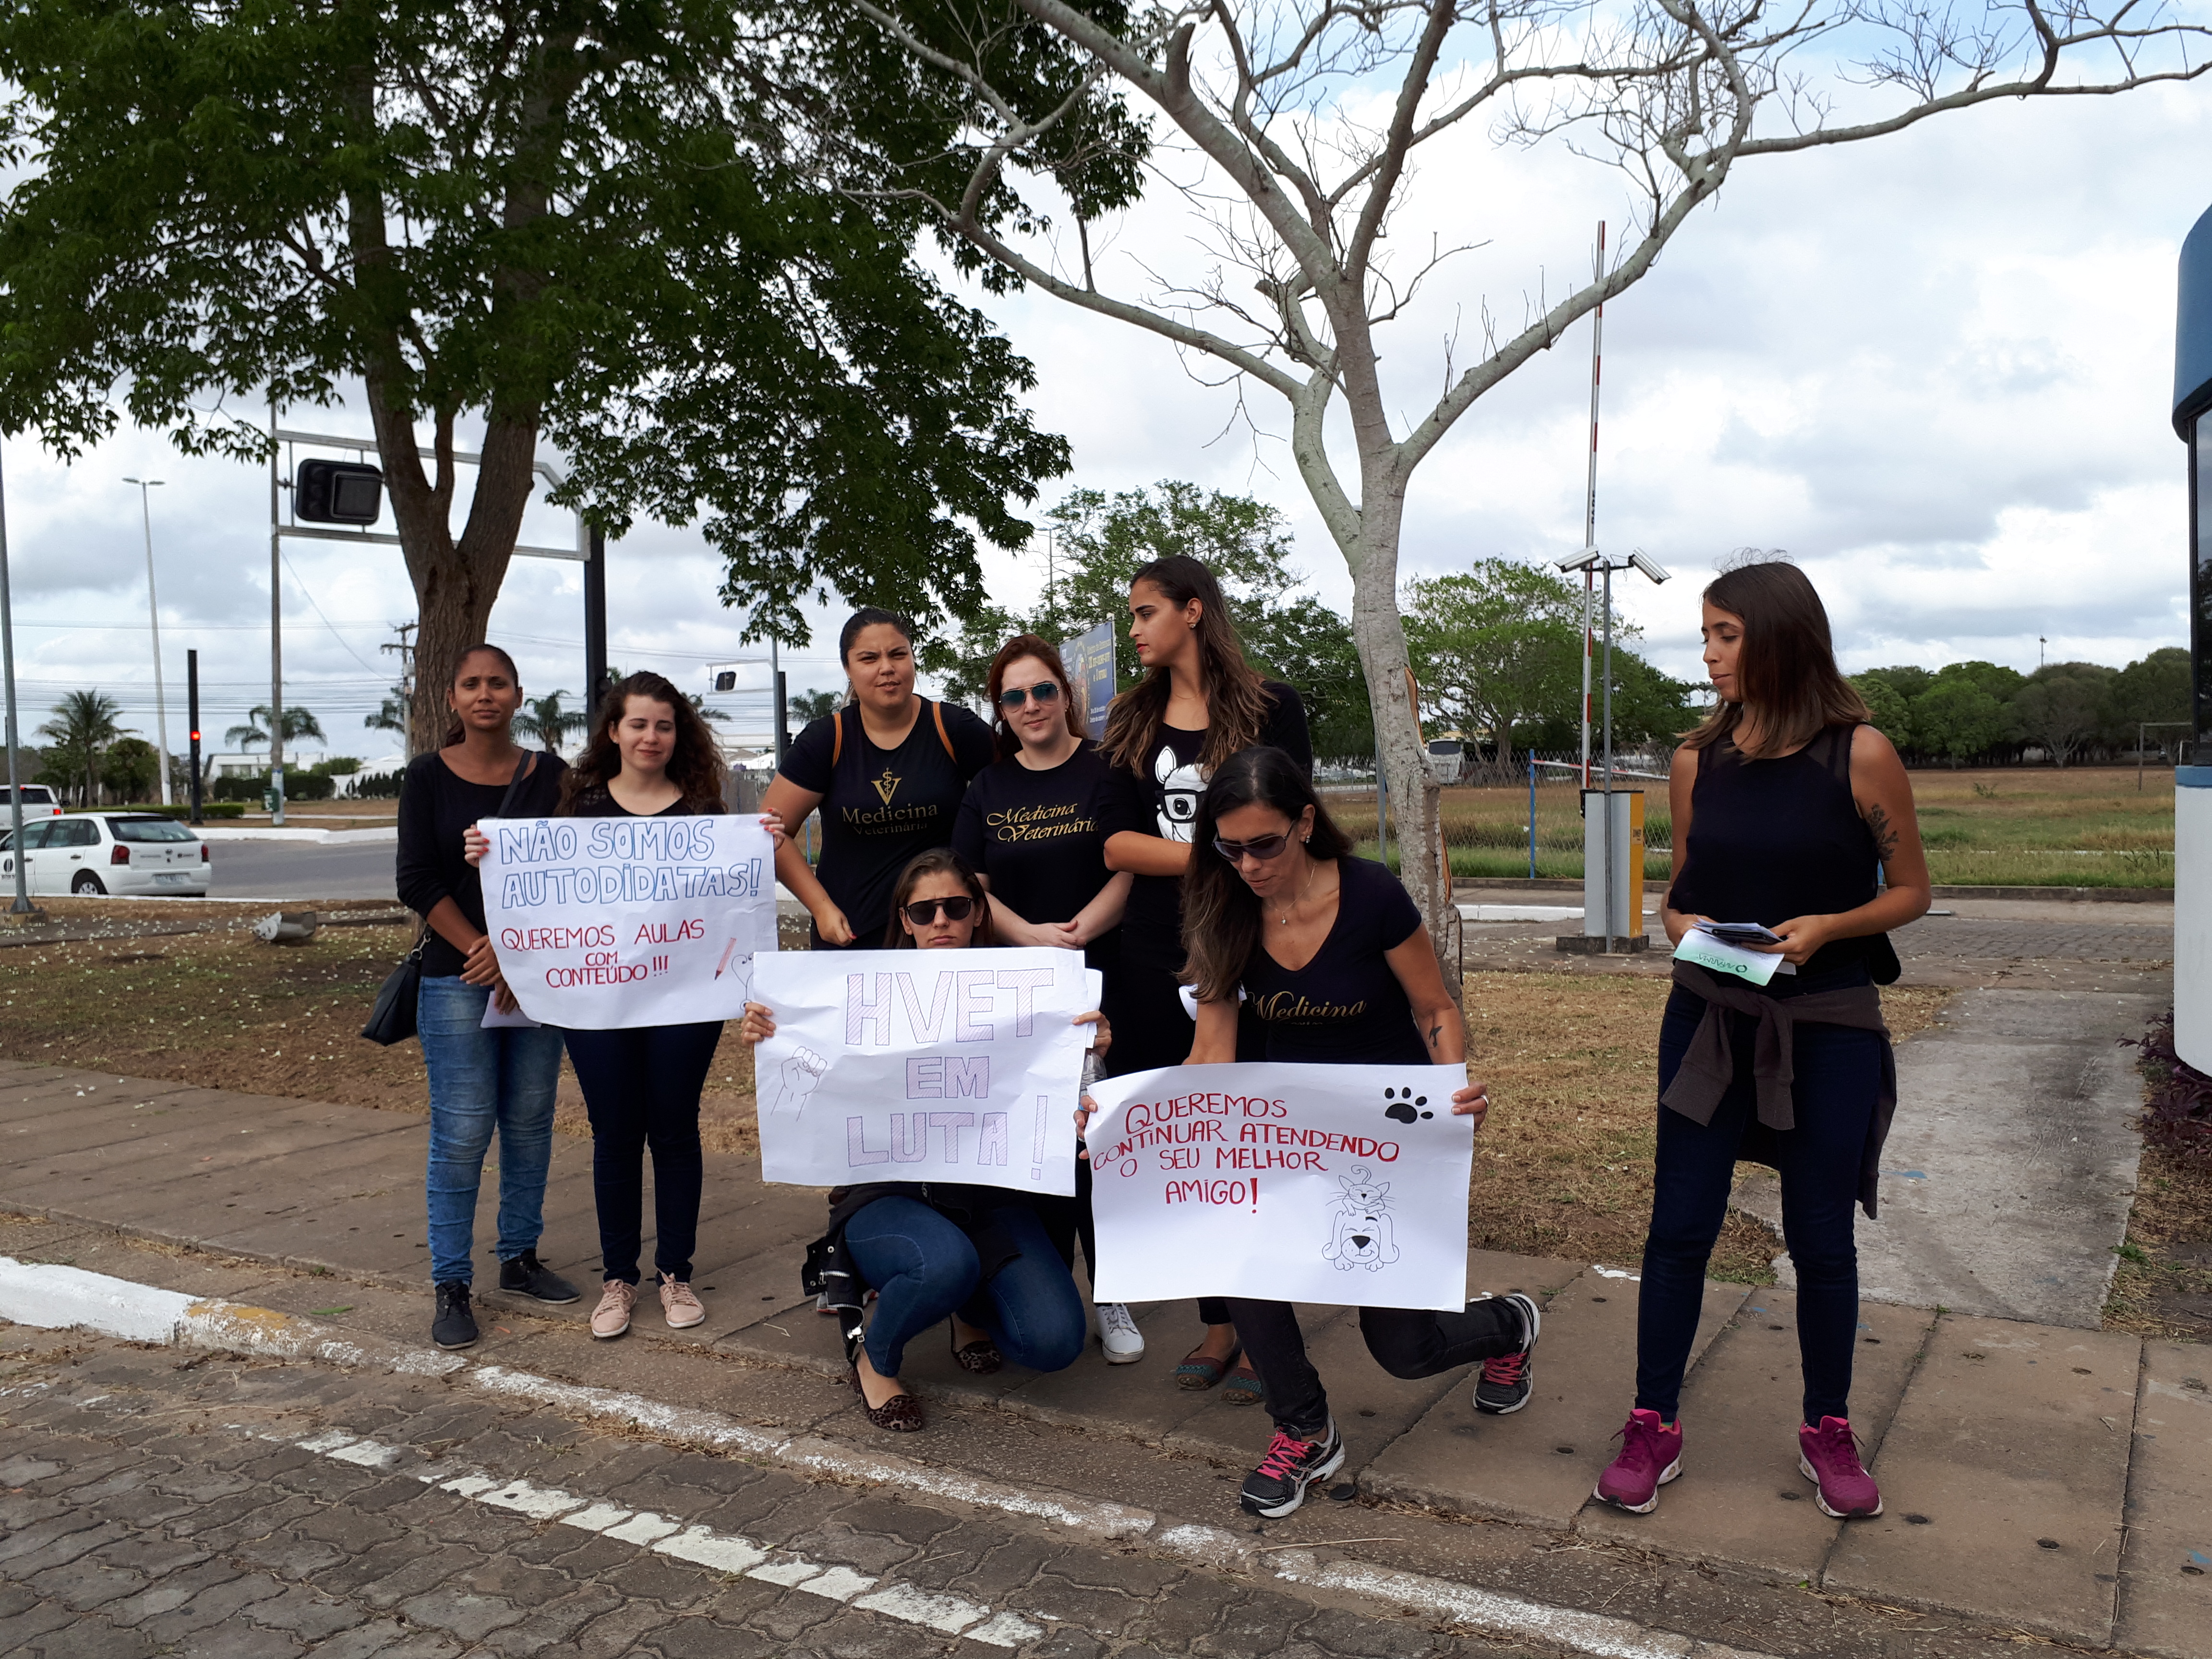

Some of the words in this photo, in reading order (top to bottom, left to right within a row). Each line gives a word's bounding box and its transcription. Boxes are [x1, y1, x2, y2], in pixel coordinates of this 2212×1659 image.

[842, 803, 938, 825] Medicina
[852, 820, 927, 836] Veterinária
[986, 803, 1078, 827] Medicina
[997, 817, 1099, 843] Veterinária
[499, 820, 577, 865] NÃO
[587, 819, 715, 862] SOMOS
[501, 925, 615, 952] QUEREMOS
[634, 918, 705, 946] AULAS
[585, 950, 618, 967] COM
[845, 968, 1054, 1046] HVET
[1246, 990, 1367, 1022] Medicina
[906, 1056, 989, 1099] EM
[1125, 1092, 1287, 1135] QUEREMOS
[1093, 1119, 1228, 1172] CONTINUAR
[1239, 1122, 1400, 1163] ATENDENDO
[1120, 1158, 1138, 1178] O
[1159, 1148, 1201, 1171] SEU
[1215, 1147, 1329, 1172] MELHOR
